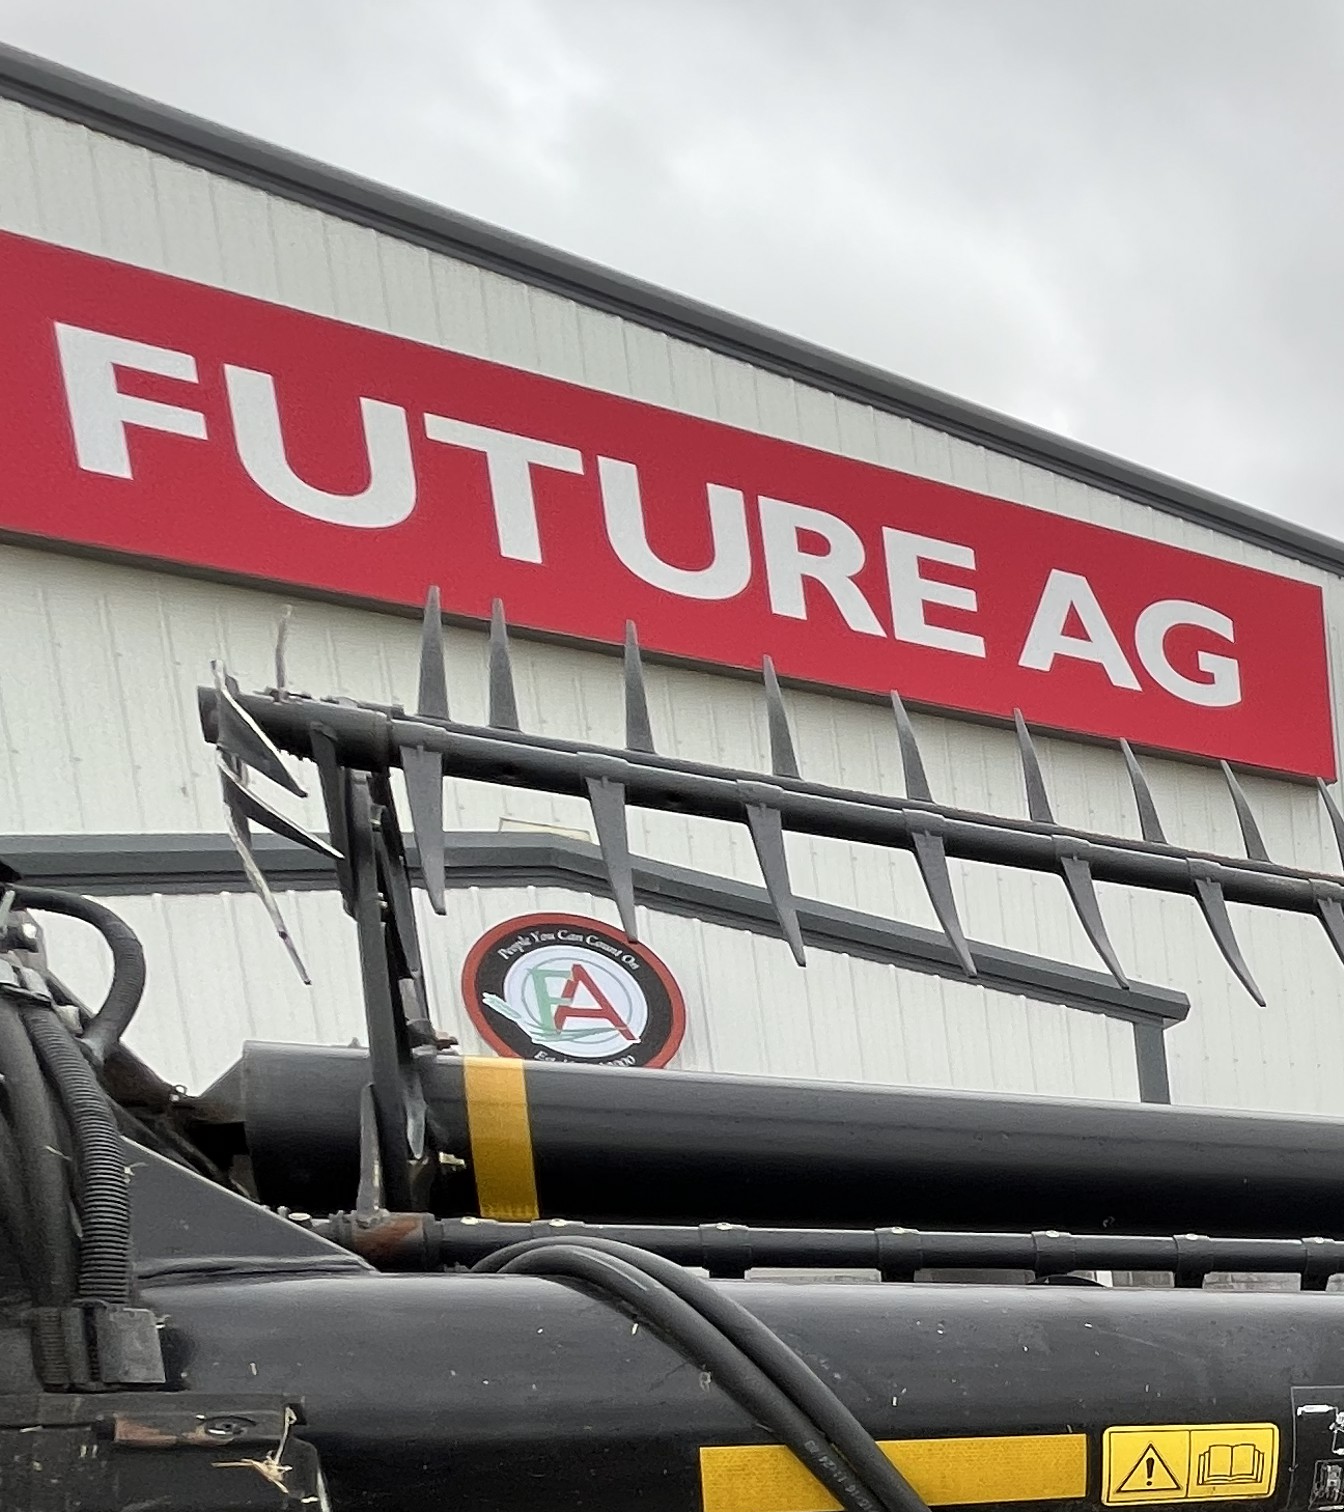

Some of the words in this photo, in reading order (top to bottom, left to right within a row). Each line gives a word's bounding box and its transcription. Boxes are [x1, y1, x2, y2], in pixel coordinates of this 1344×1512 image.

[53, 320, 987, 659] FUTURE
[1018, 568, 1242, 708] AG
[497, 935, 532, 960] People
[530, 930, 556, 943] You
[557, 929, 584, 942] Can
[585, 934, 623, 957] Count
[621, 954, 640, 970] On
